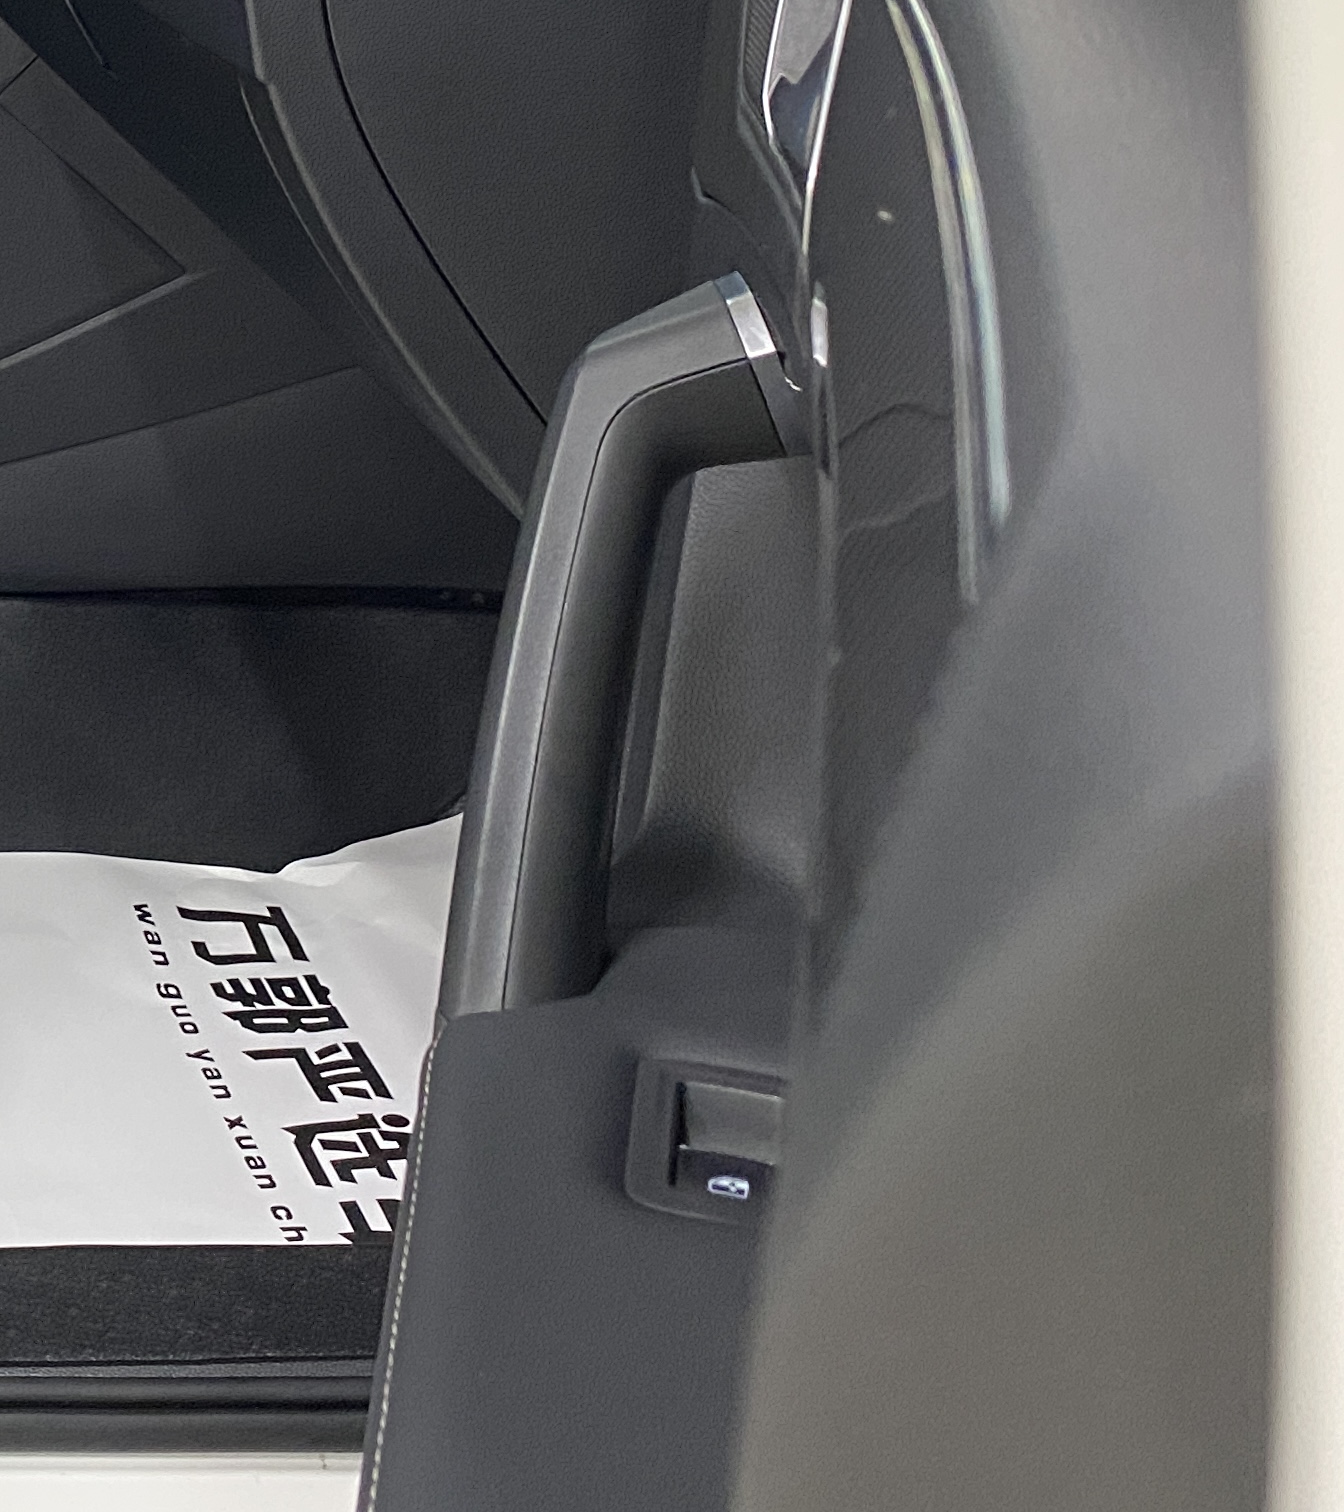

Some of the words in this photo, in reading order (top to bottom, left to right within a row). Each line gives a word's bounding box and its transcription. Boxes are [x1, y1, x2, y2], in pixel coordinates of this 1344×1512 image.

[133, 904, 170, 966] wan
[156, 982, 199, 1035] guo
[185, 1049, 232, 1099] yan
[223, 1115, 277, 1189] xuan
